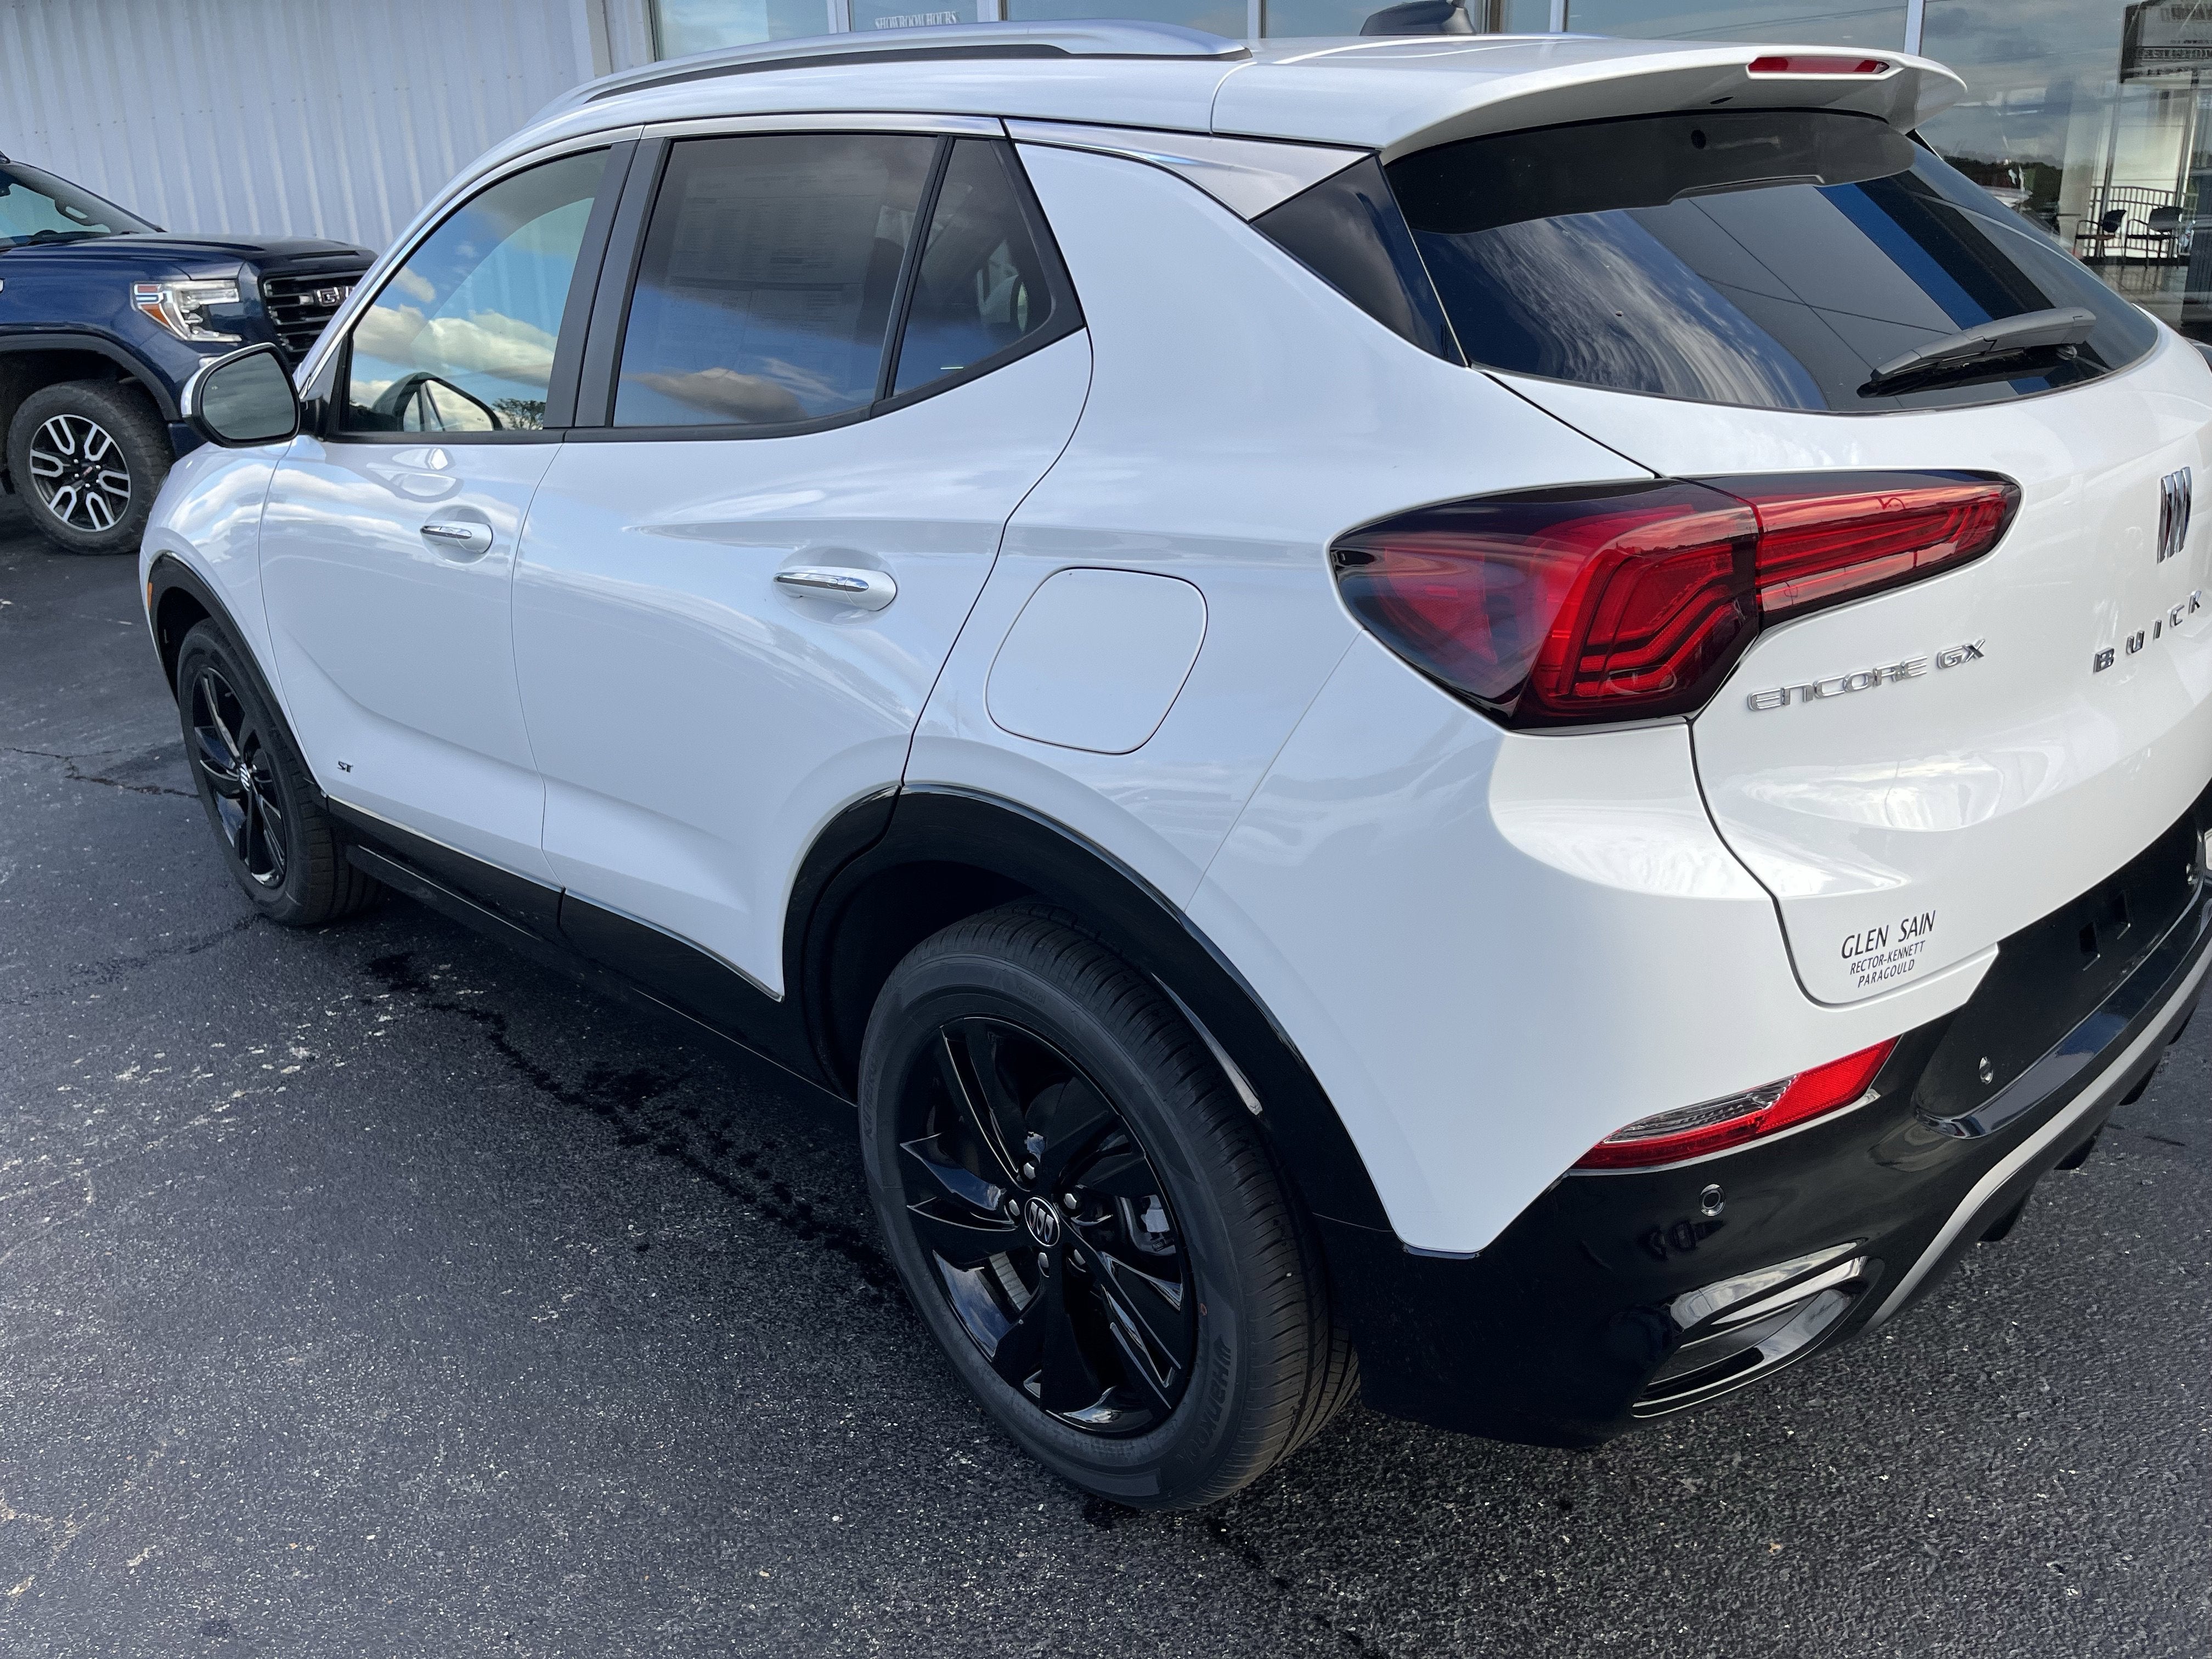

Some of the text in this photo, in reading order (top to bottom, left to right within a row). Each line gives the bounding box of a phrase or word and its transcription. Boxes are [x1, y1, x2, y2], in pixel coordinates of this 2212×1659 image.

[874, 11, 958, 30] SHOWROOM HOURS
[2093, 590, 2202, 673] BUICK
[1747, 639, 1985, 712] ENCORE GX
[337, 760, 354, 773] ST
[1841, 910, 1936, 959] GLEN SAIN
[1849, 940, 1926, 975] RECTOR-KENNETT
[1858, 959, 1915, 988] PARAGOULD
